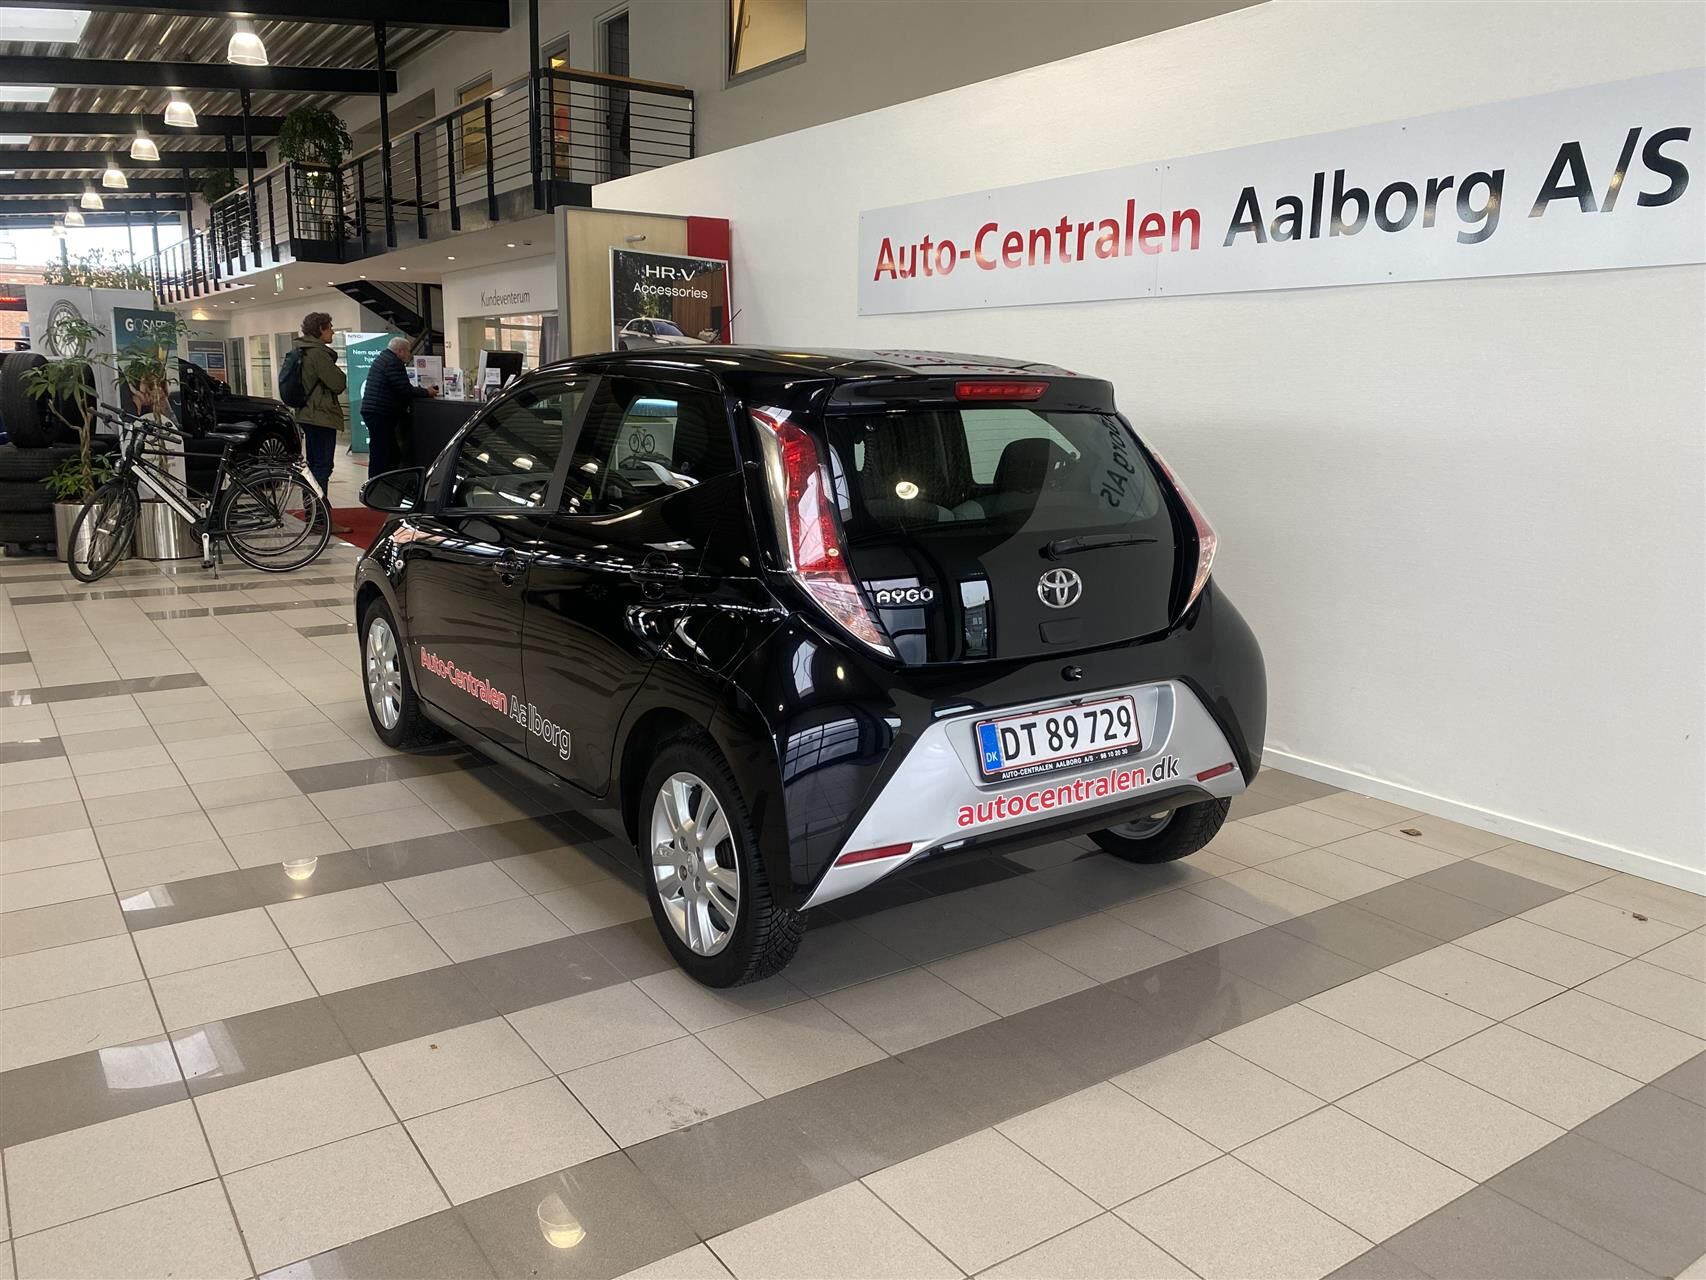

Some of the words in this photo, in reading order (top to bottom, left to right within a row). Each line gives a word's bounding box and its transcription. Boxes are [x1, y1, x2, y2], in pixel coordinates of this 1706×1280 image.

[873, 198, 1202, 282] Auto-Centralen
[1223, 166, 1505, 244] Aalborg
[1529, 126, 1692, 218] A/S
[645, 264, 696, 281] HR-V
[480, 288, 530, 307] Kundeventerum
[633, 282, 709, 299] Accessories
[876, 587, 934, 604] AYGO
[420, 646, 508, 715] Auto-Centralen
[509, 694, 572, 761] Aalborg
[1001, 722, 1037, 761] DT
[1045, 715, 1079, 752] 89
[1083, 705, 1132, 744] 729
[985, 751, 999, 763] DK
[1002, 762, 1054, 779] AUTO-CENTRALEN
[1055, 757, 1082, 769] AALBORG
[957, 755, 1180, 827] autocentralen.dk
